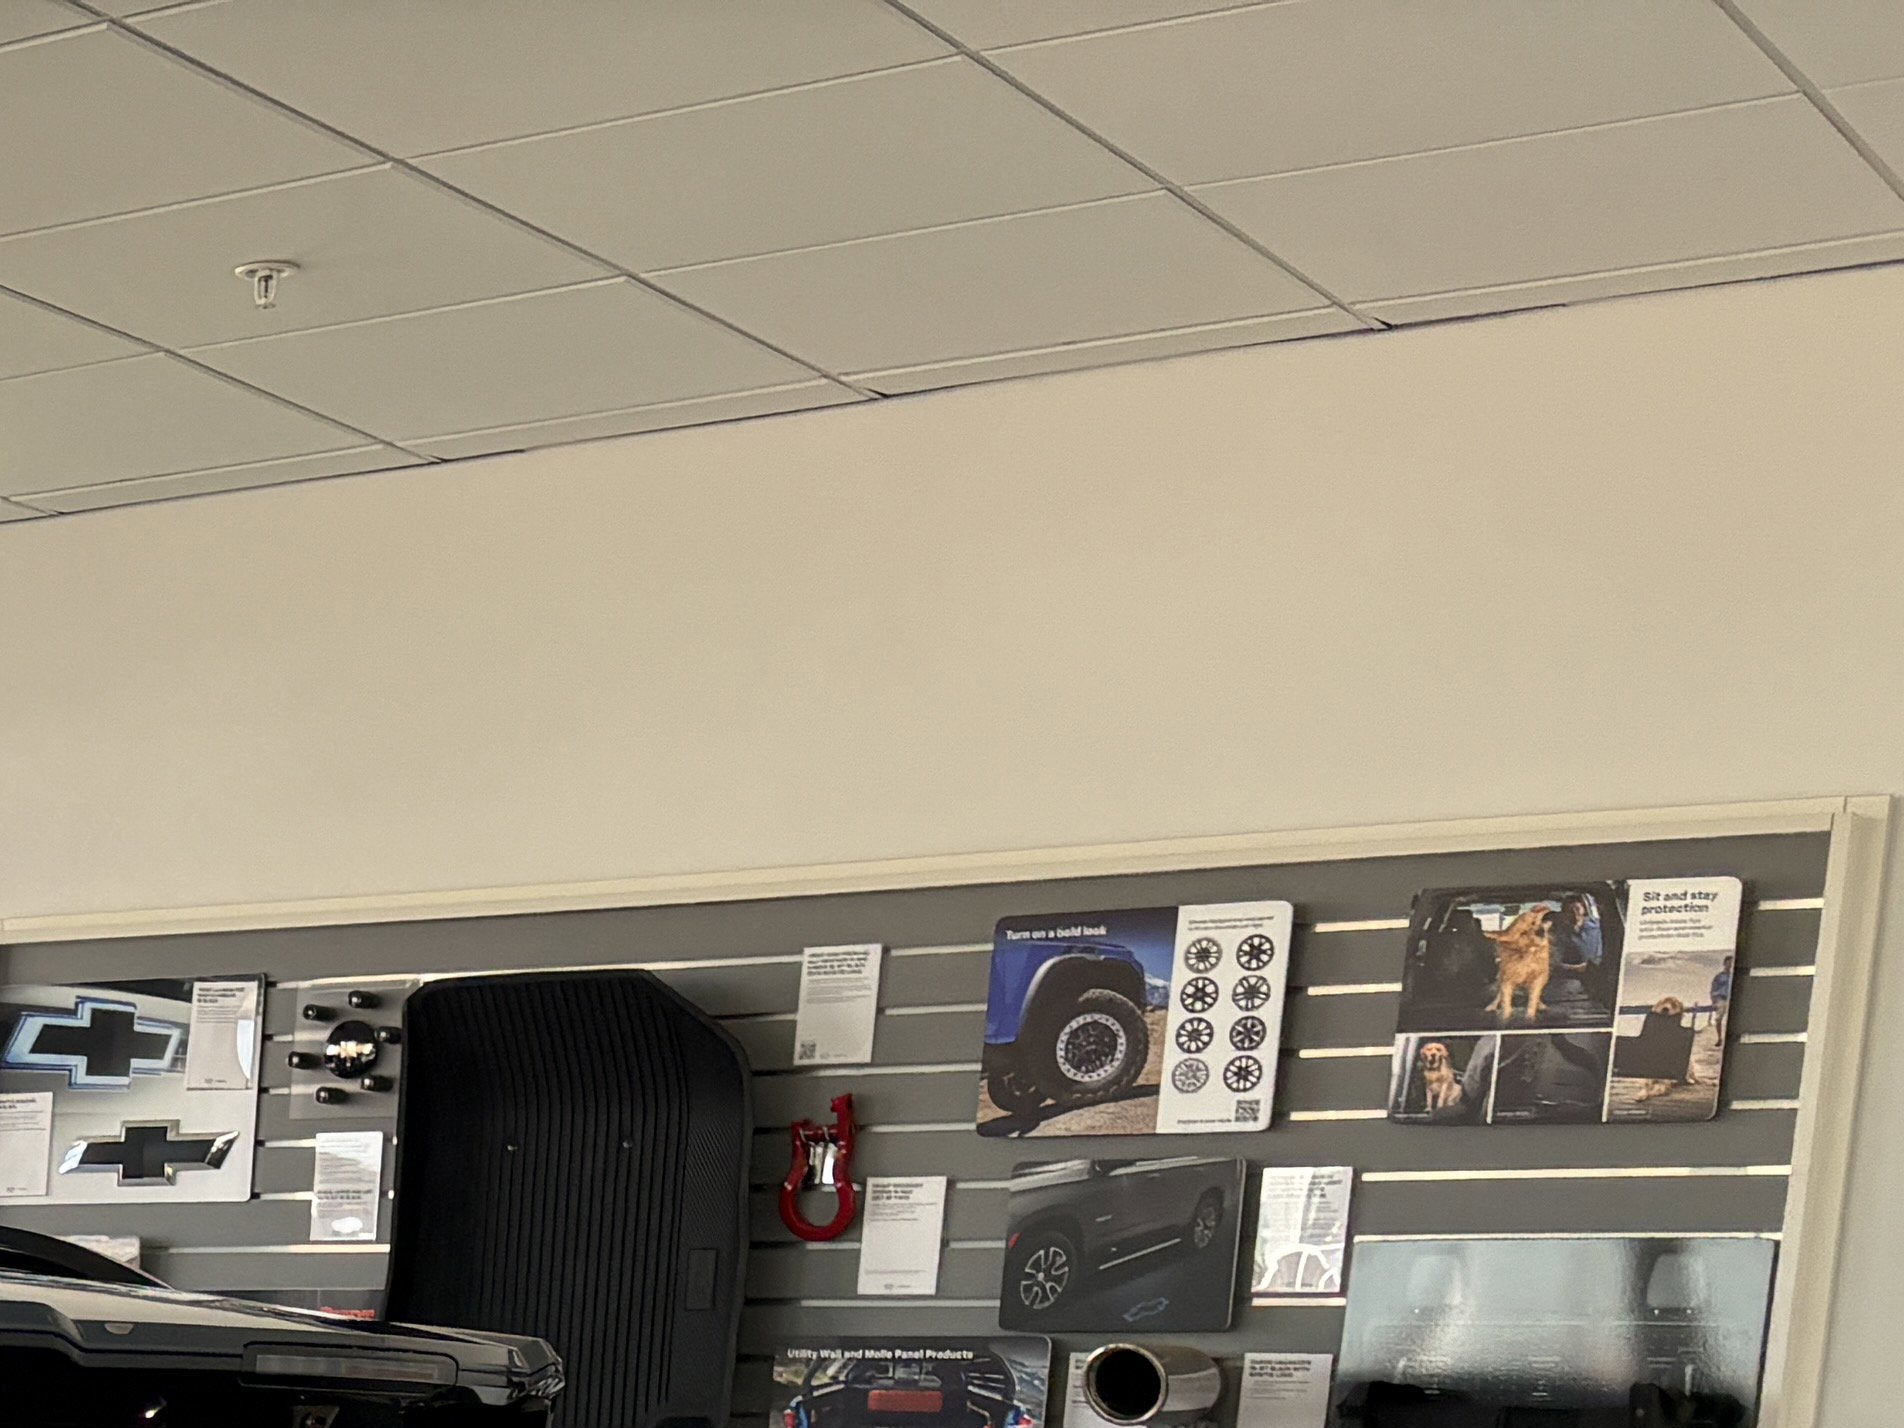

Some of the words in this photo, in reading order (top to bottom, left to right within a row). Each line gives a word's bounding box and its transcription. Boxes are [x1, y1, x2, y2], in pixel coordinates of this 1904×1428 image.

[1643, 891, 1661, 902] Sit
[1663, 889, 1688, 902] and
[1690, 891, 1718, 903] stay
[1641, 902, 1709, 915] protection
[1005, 929, 1030, 941] Turn
[1032, 930, 1046, 940] on
[1056, 926, 1081, 939] bold
[1083, 925, 1107, 937] look
[787, 1349, 817, 1360] Utility
[819, 1349, 842, 1359] Wall
[844, 1349, 863, 1358] and
[895, 1349, 924, 1359] Panel
[926, 1349, 974, 1360] Products
